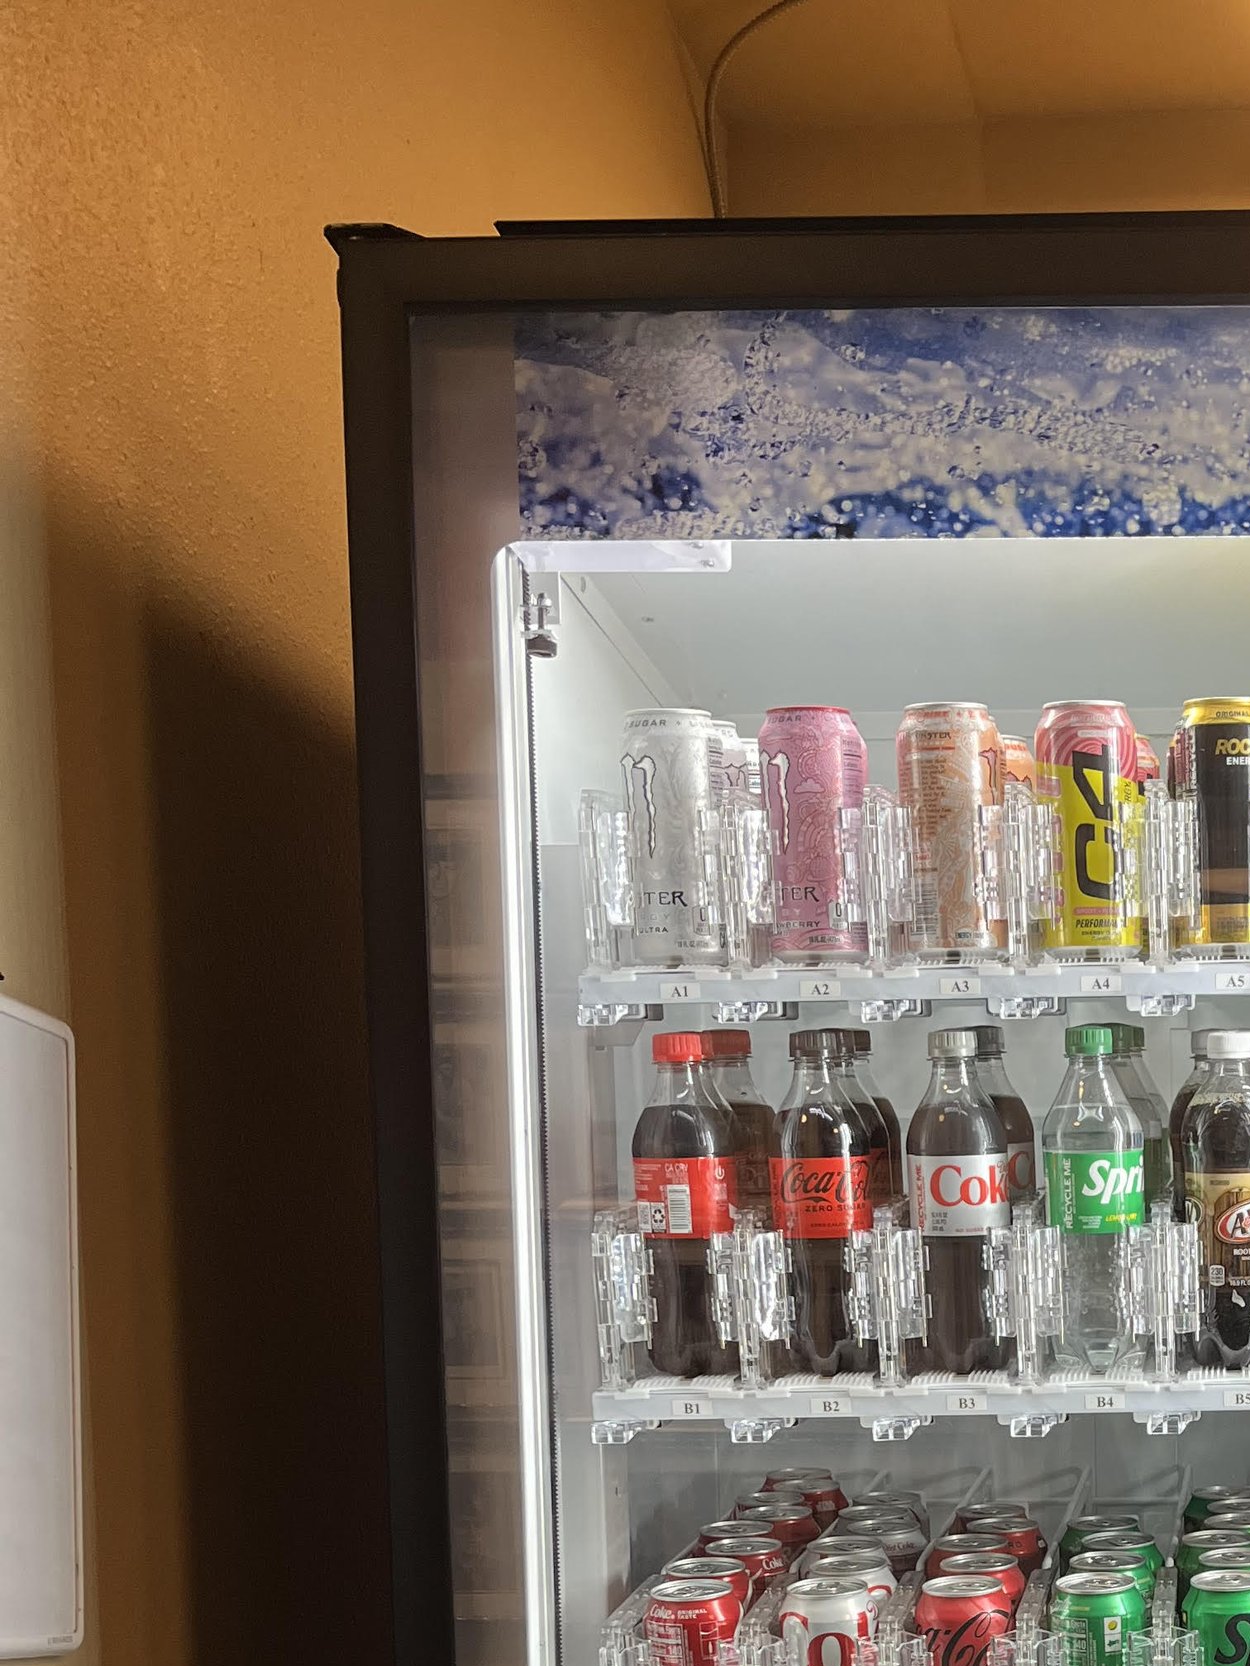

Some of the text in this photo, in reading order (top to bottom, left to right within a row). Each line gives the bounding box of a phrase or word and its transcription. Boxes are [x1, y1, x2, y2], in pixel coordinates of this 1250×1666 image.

[950, 981, 969, 992] A3
[1091, 978, 1110, 990] A4
[1226, 976, 1245, 988] A5
[671, 985, 689, 997] A1
[811, 984, 830, 996] A2
[1063, 1158, 1073, 1229] RECYCLE ME
[805, 1204, 833, 1213] ZERO
[683, 1402, 700, 1414] B1
[822, 1401, 840, 1413] B2
[958, 1397, 976, 1409] B3
[1096, 1396, 1114, 1409] B4
[650, 1603, 672, 1619] Coke
